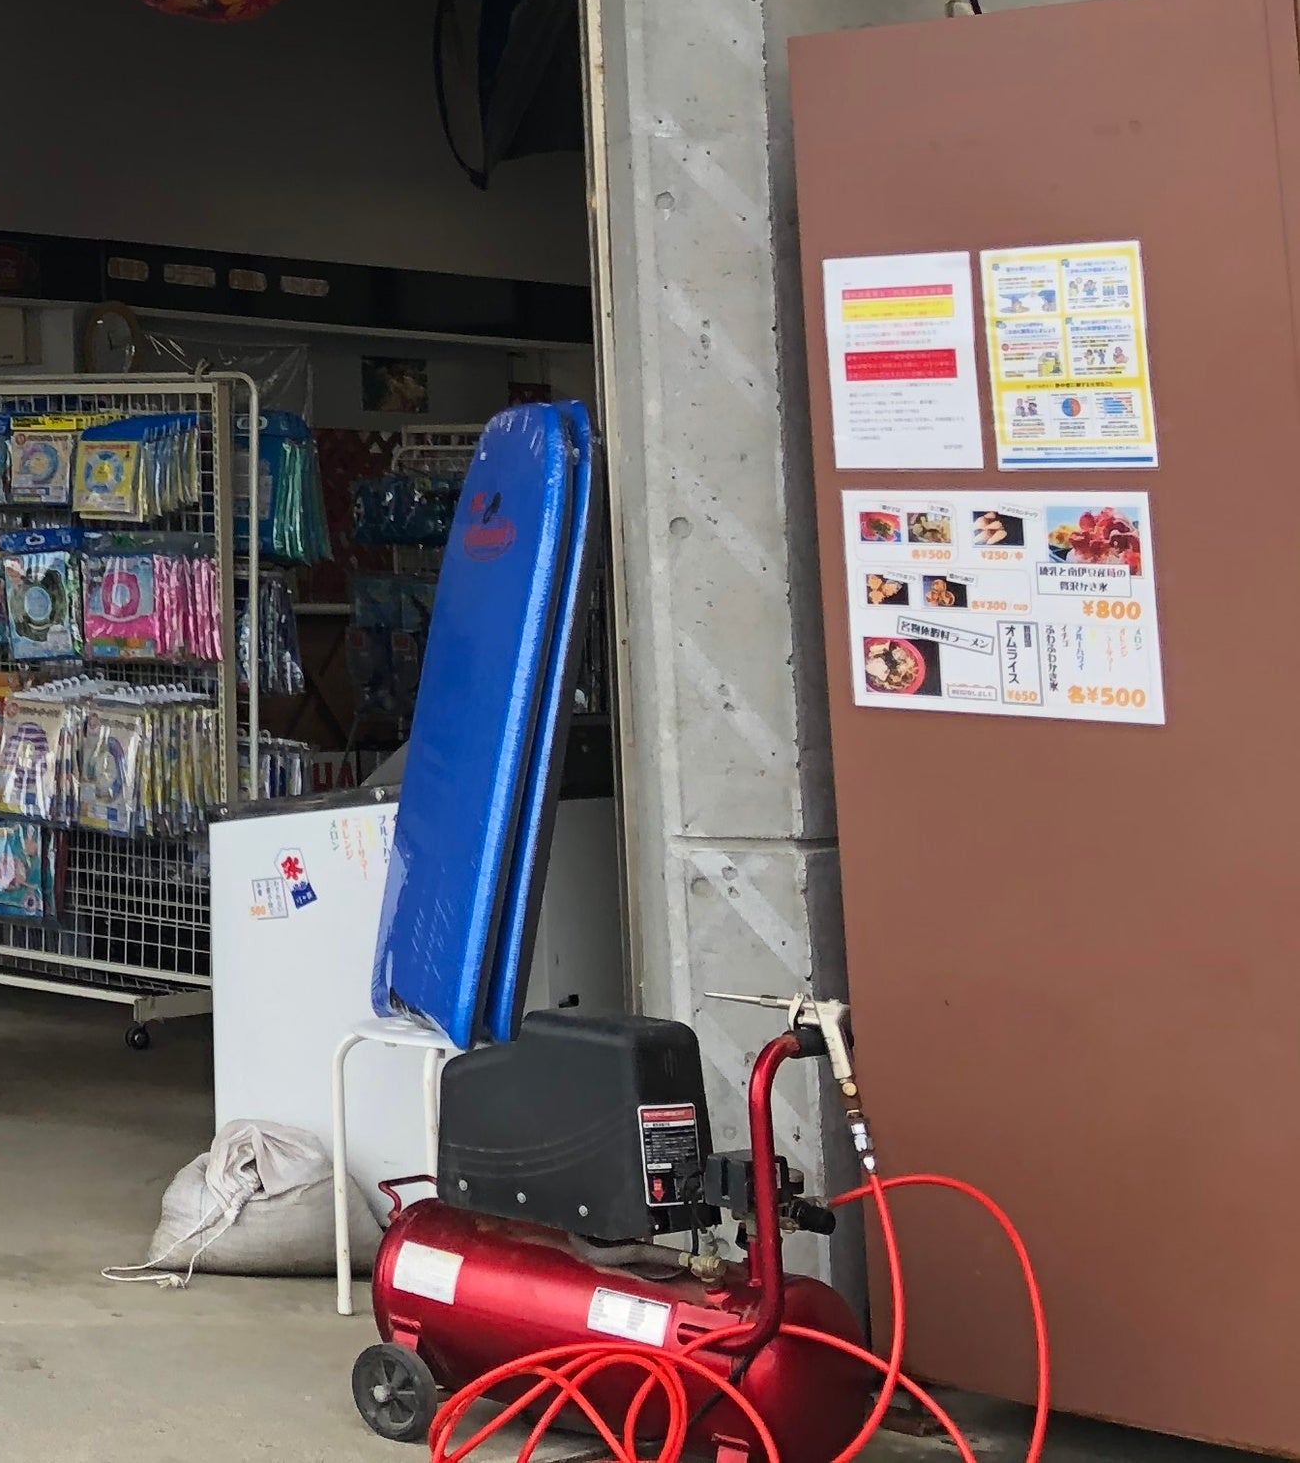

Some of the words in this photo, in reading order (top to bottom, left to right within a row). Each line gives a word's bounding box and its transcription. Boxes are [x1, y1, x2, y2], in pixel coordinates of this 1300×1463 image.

[1082, 600, 1142, 621] ¥800
[1004, 625, 1020, 685] オムライス
[1068, 684, 1146, 708] 各¥500
[281, 855, 303, 881] 氷
